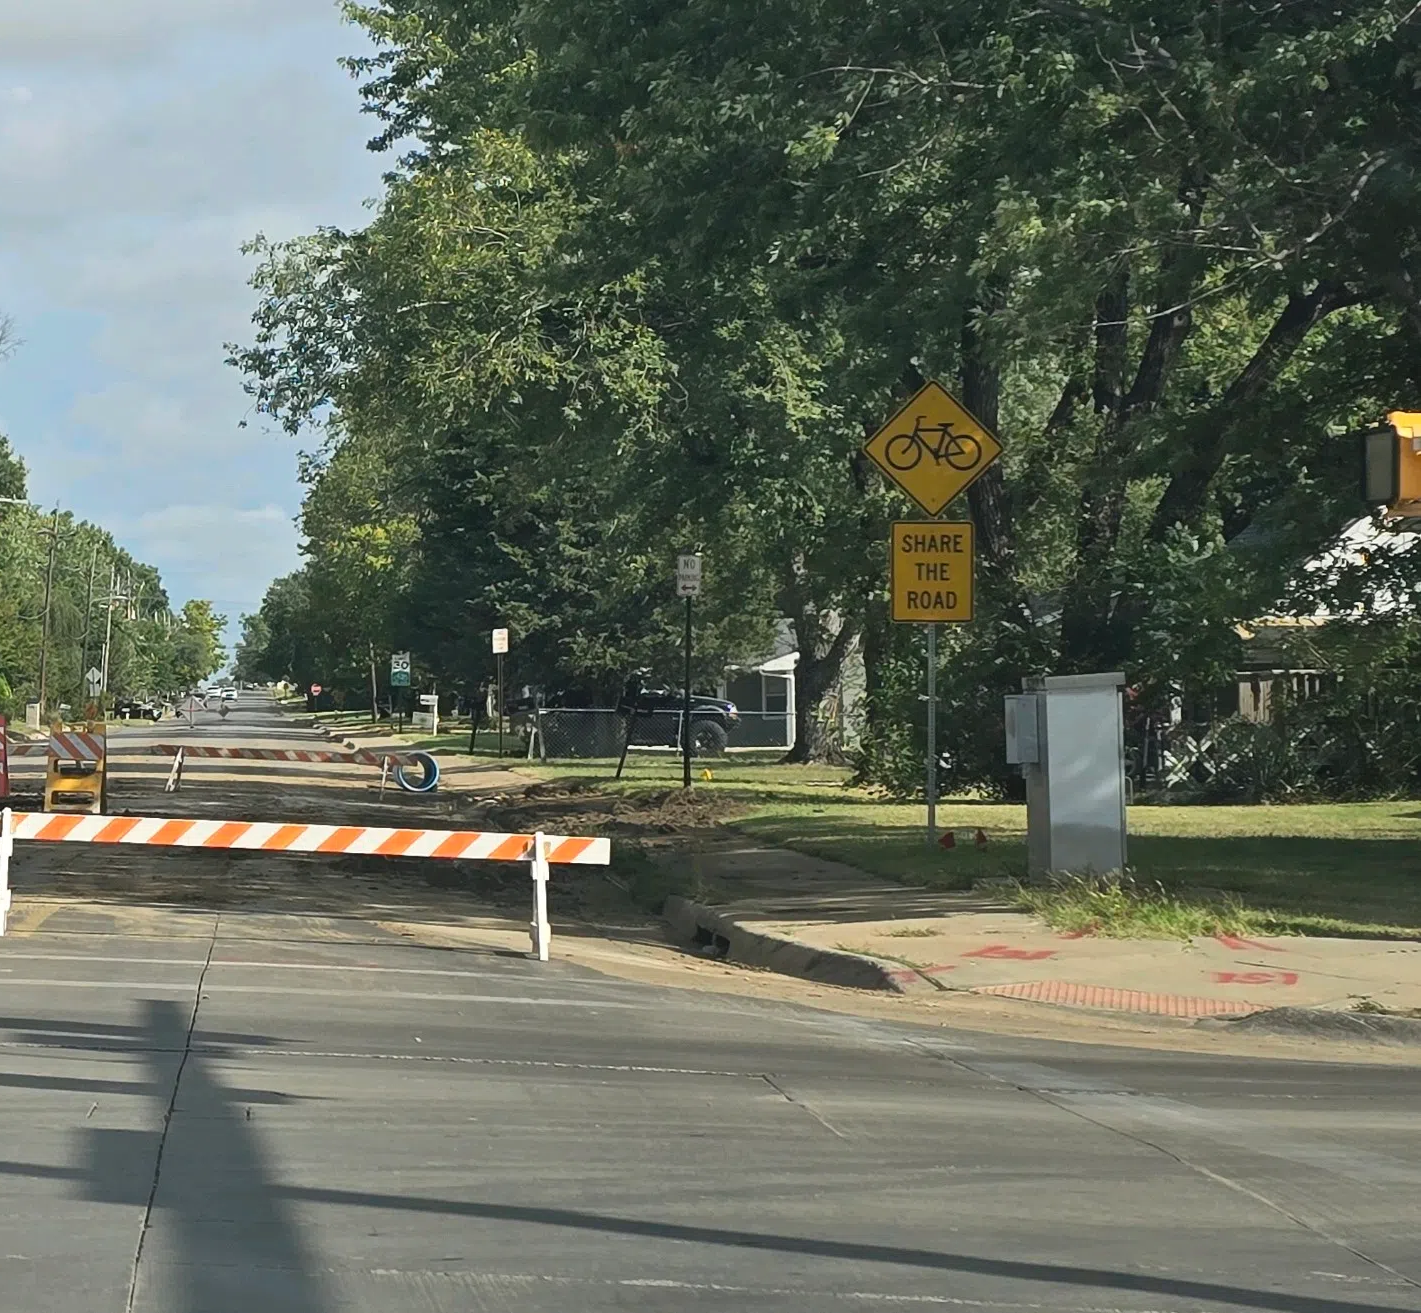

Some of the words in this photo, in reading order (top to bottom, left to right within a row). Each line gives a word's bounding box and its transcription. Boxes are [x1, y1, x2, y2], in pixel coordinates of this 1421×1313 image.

[901, 534, 964, 553] SHARE
[683, 559, 696, 569] NO
[914, 562, 951, 581] THE
[906, 591, 958, 610] ROAD
